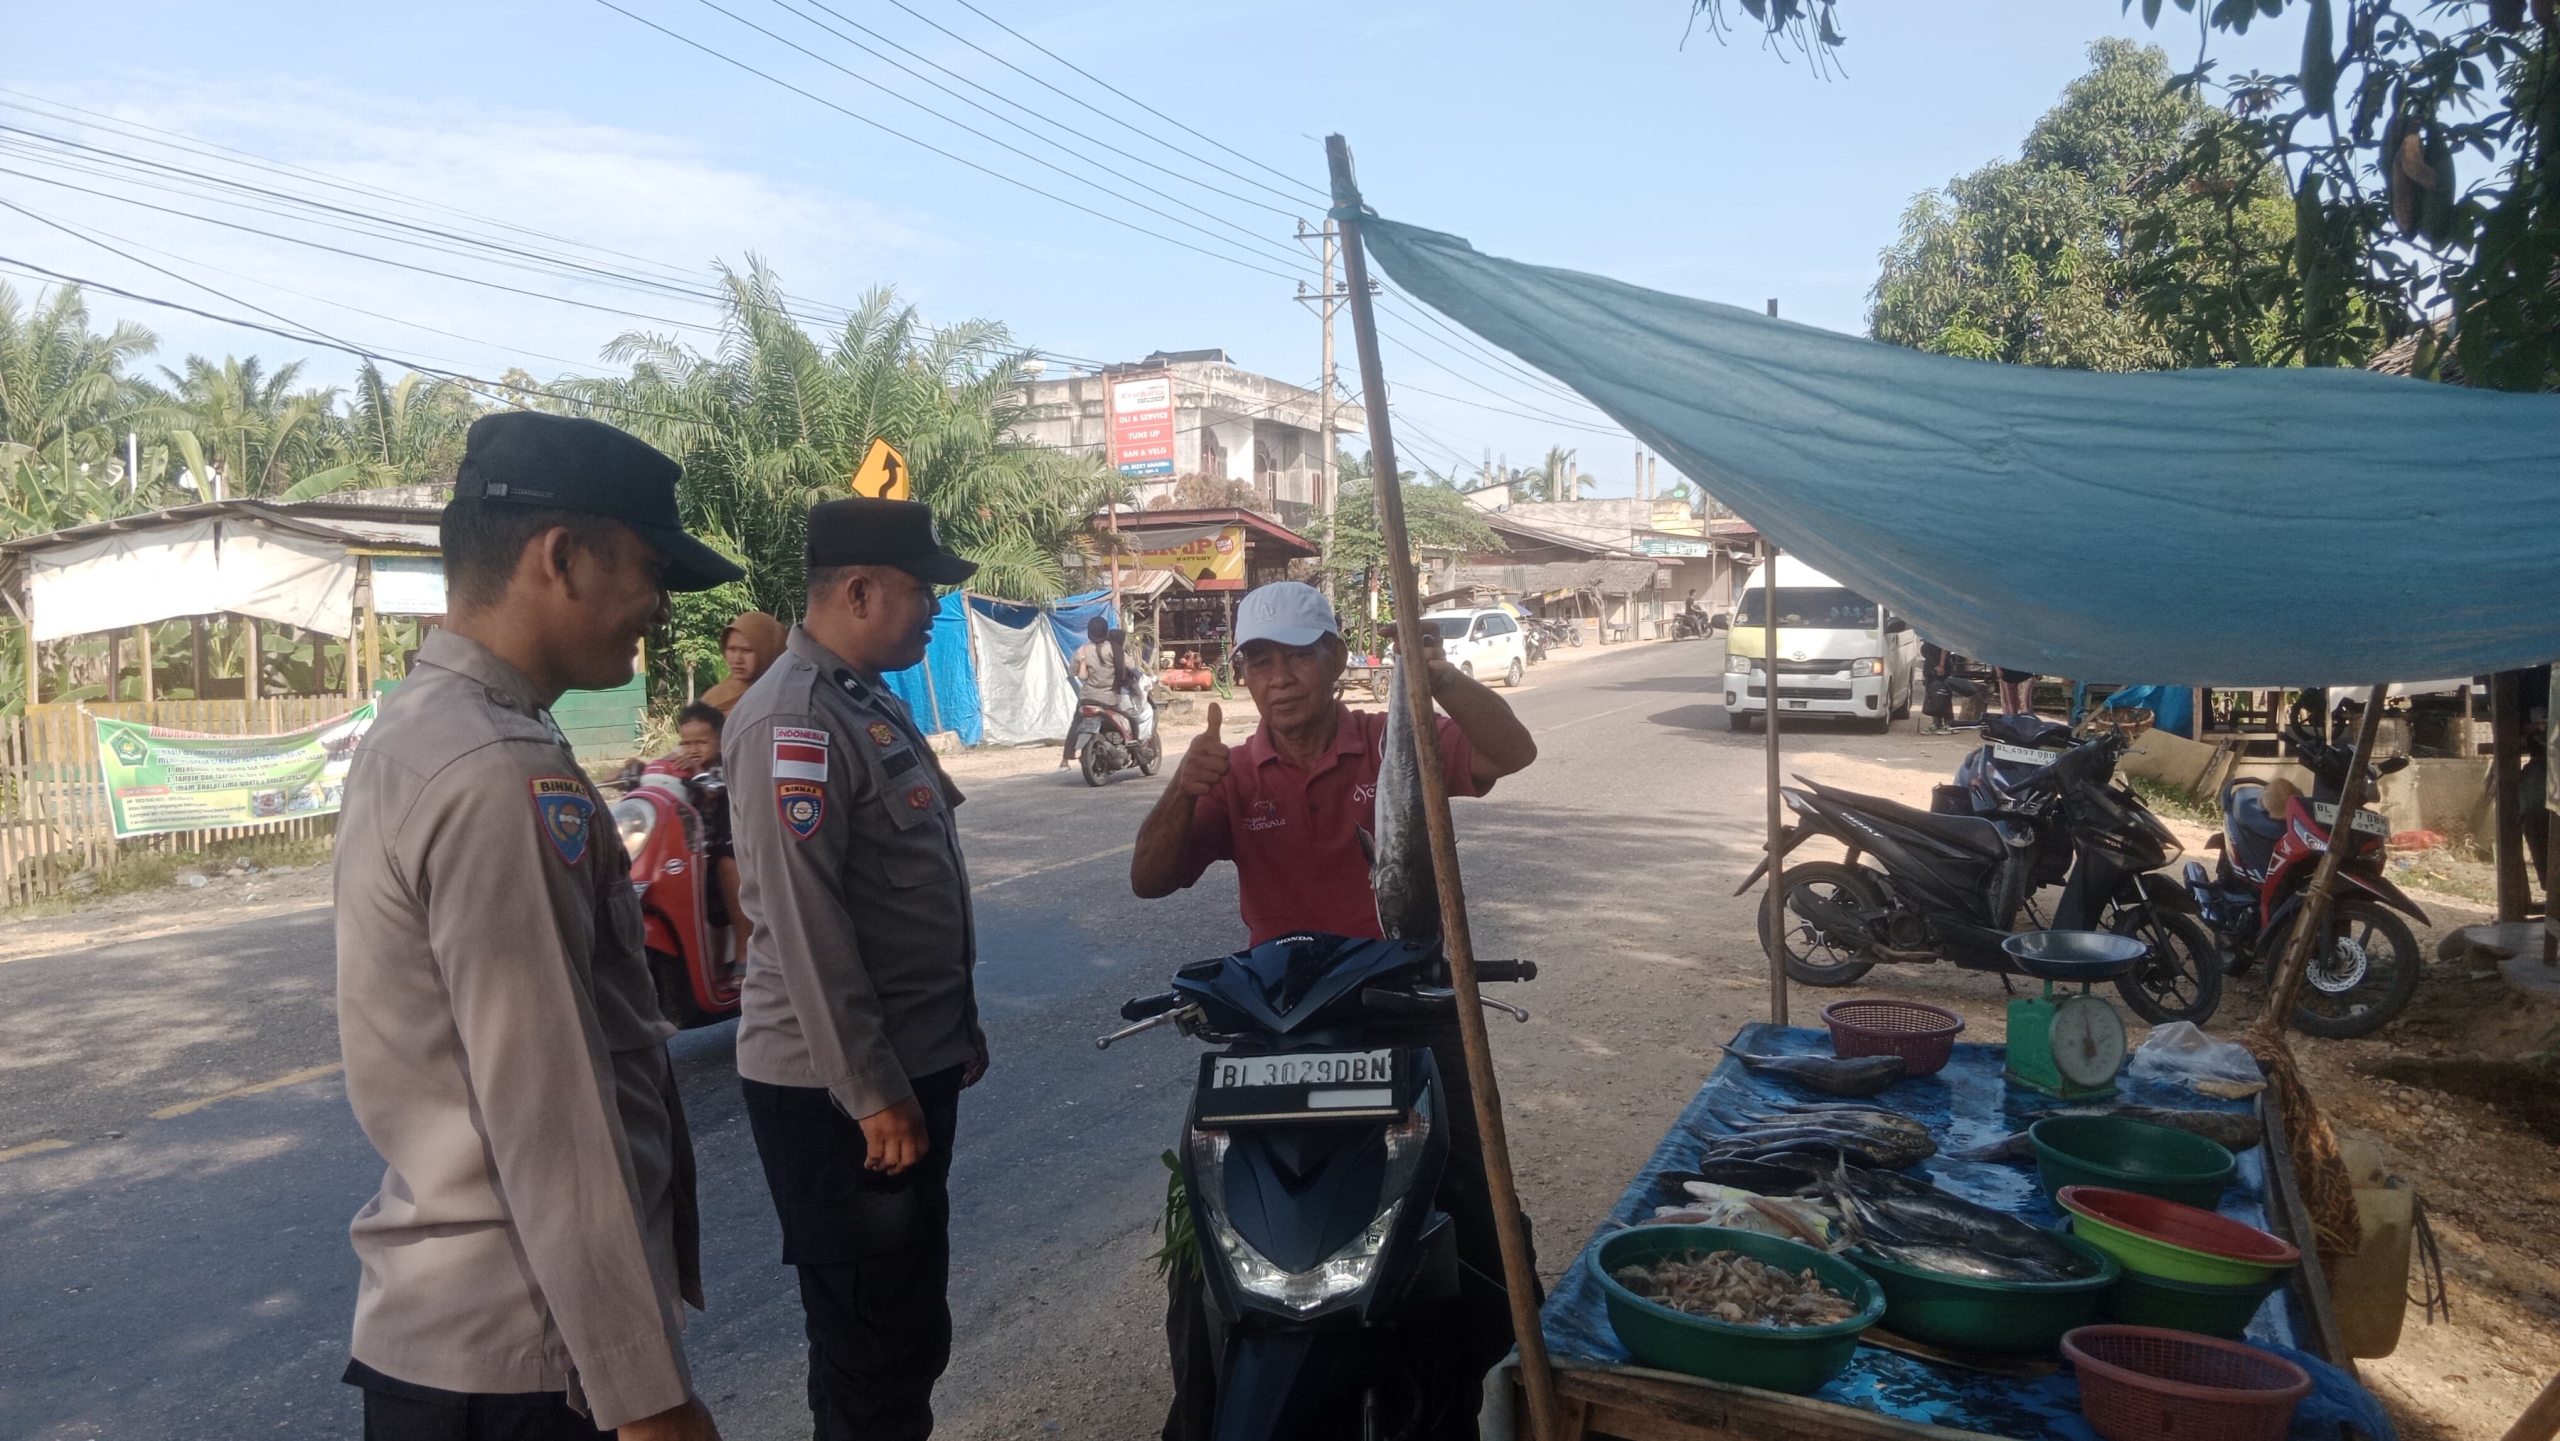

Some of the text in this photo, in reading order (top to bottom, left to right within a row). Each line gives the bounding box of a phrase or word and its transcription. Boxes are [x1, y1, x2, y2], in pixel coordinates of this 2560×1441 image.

[1119, 416, 1131, 424] OLI
[1140, 411, 1168, 421] SERVICE
[1128, 430, 1160, 440] TUNE UP
[1123, 449, 1139, 458] BAN
[1147, 446, 1167, 455] VELG
[778, 730, 826, 741] INDONESIA
[1996, 744, 2010, 752] BL
[176, 784, 195, 792] IMAM
[197, 783, 220, 791] SHALAT
[540, 781, 586, 795] BINMAS
[784, 786, 818, 795] BINMAS
[2316, 803, 2331, 814] BL
[1275, 935, 1315, 946] HONDA
